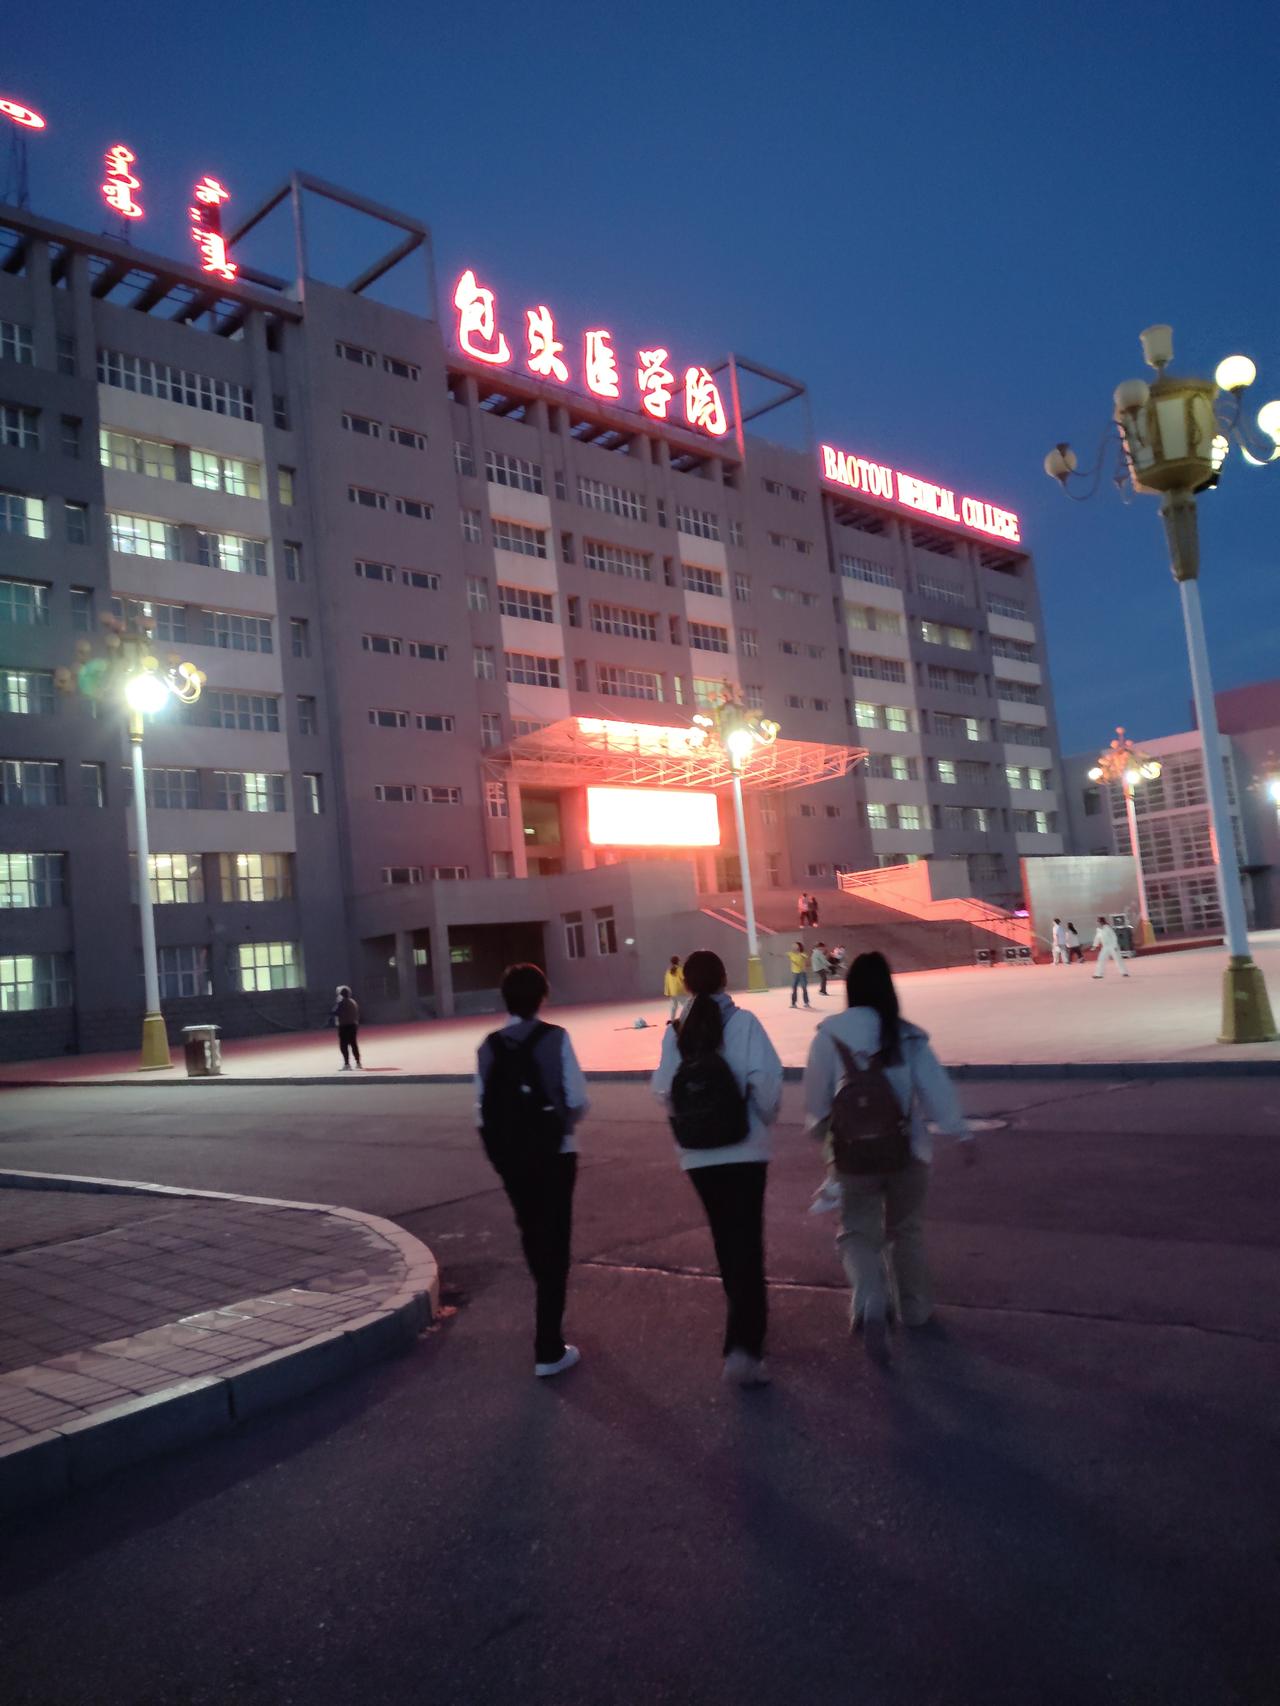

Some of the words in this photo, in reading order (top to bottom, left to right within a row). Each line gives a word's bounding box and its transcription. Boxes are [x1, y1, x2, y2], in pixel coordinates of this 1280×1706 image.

[454, 269, 726, 437] 包头医学院
[822, 445, 893, 500] BAOTOU
[896, 472, 960, 523] MEDICAL
[962, 496, 1019, 543] COLLEGE
